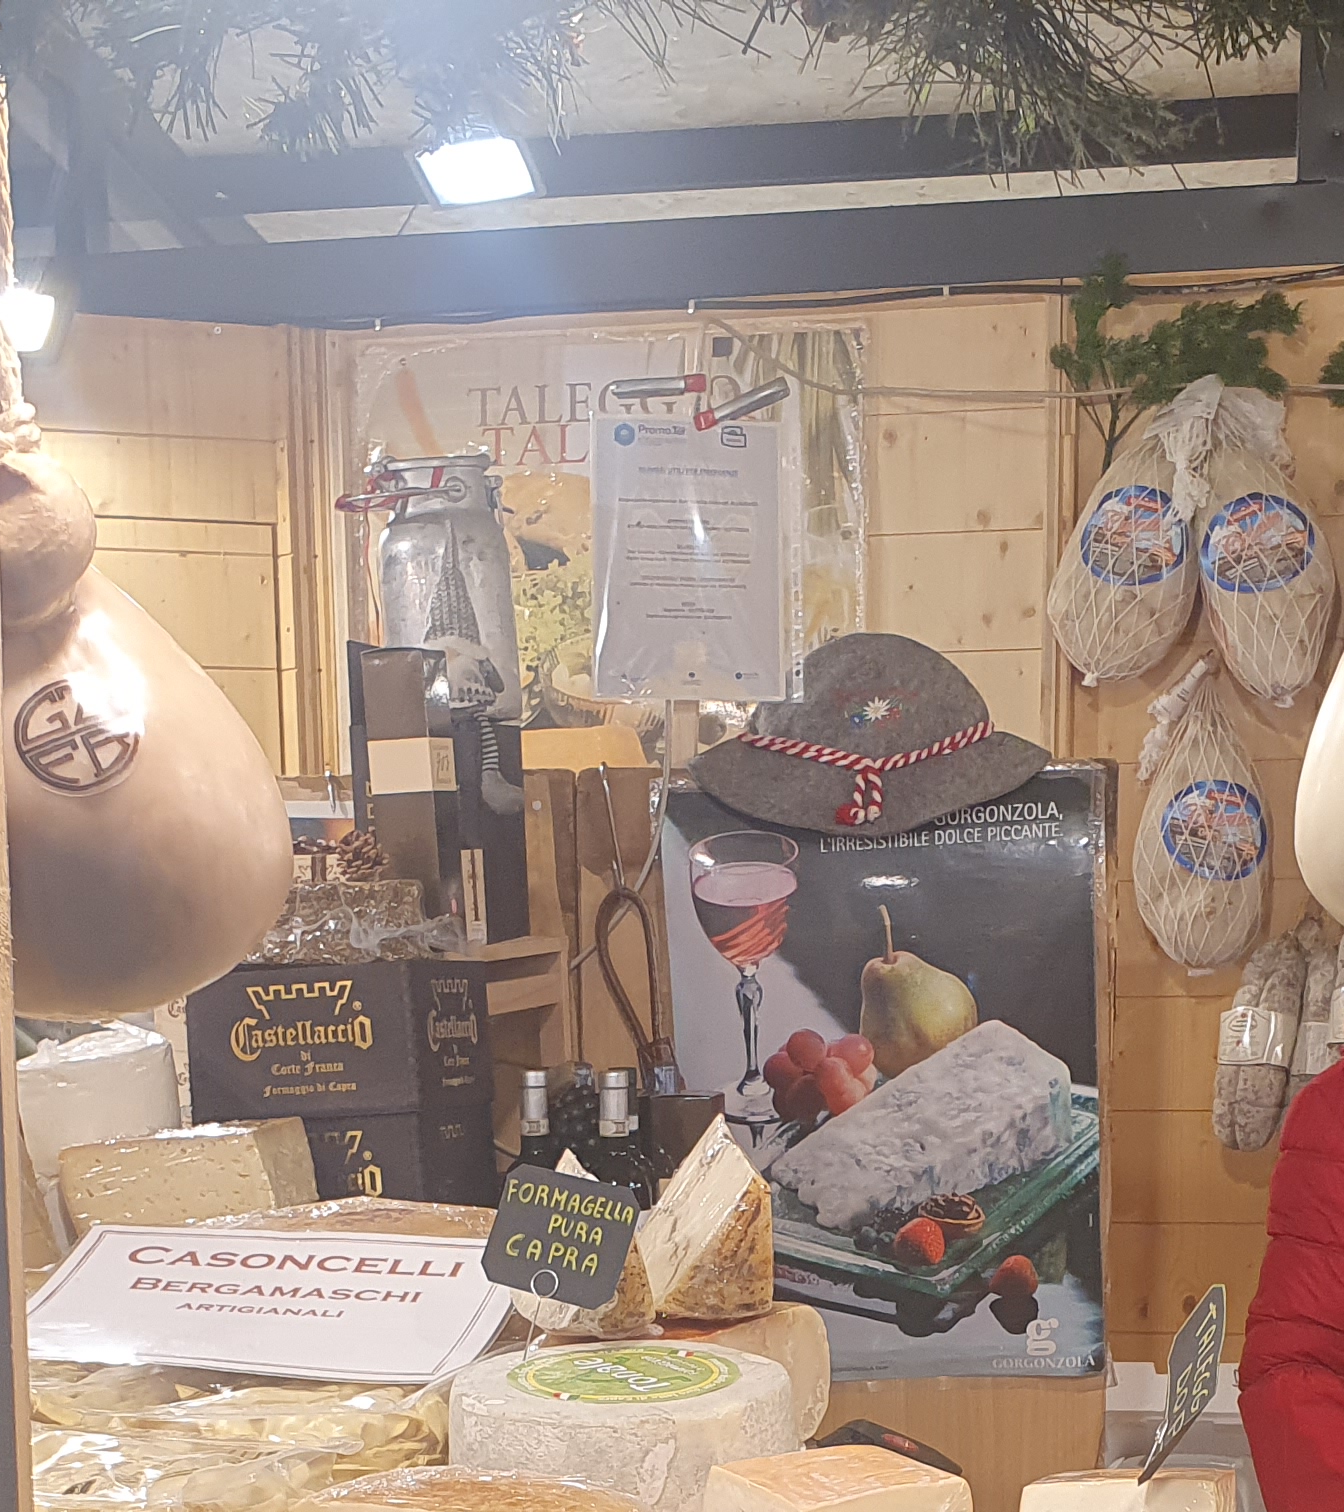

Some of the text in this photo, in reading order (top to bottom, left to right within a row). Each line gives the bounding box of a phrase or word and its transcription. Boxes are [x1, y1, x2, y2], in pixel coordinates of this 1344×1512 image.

[935, 827, 983, 847] DOLCE
[987, 822, 1064, 843] PICCANTE.
[506, 1178, 636, 1227] FORMAGELLA
[547, 1213, 603, 1246] PURA
[128, 1246, 465, 1278] CASONCELLI
[506, 1233, 598, 1277] CAPRA
[129, 1276, 424, 1304] BERGAMASCHI
[175, 1302, 345, 1319] ARTIGIANALI
[992, 1353, 1096, 1370] GORGONZOLA
